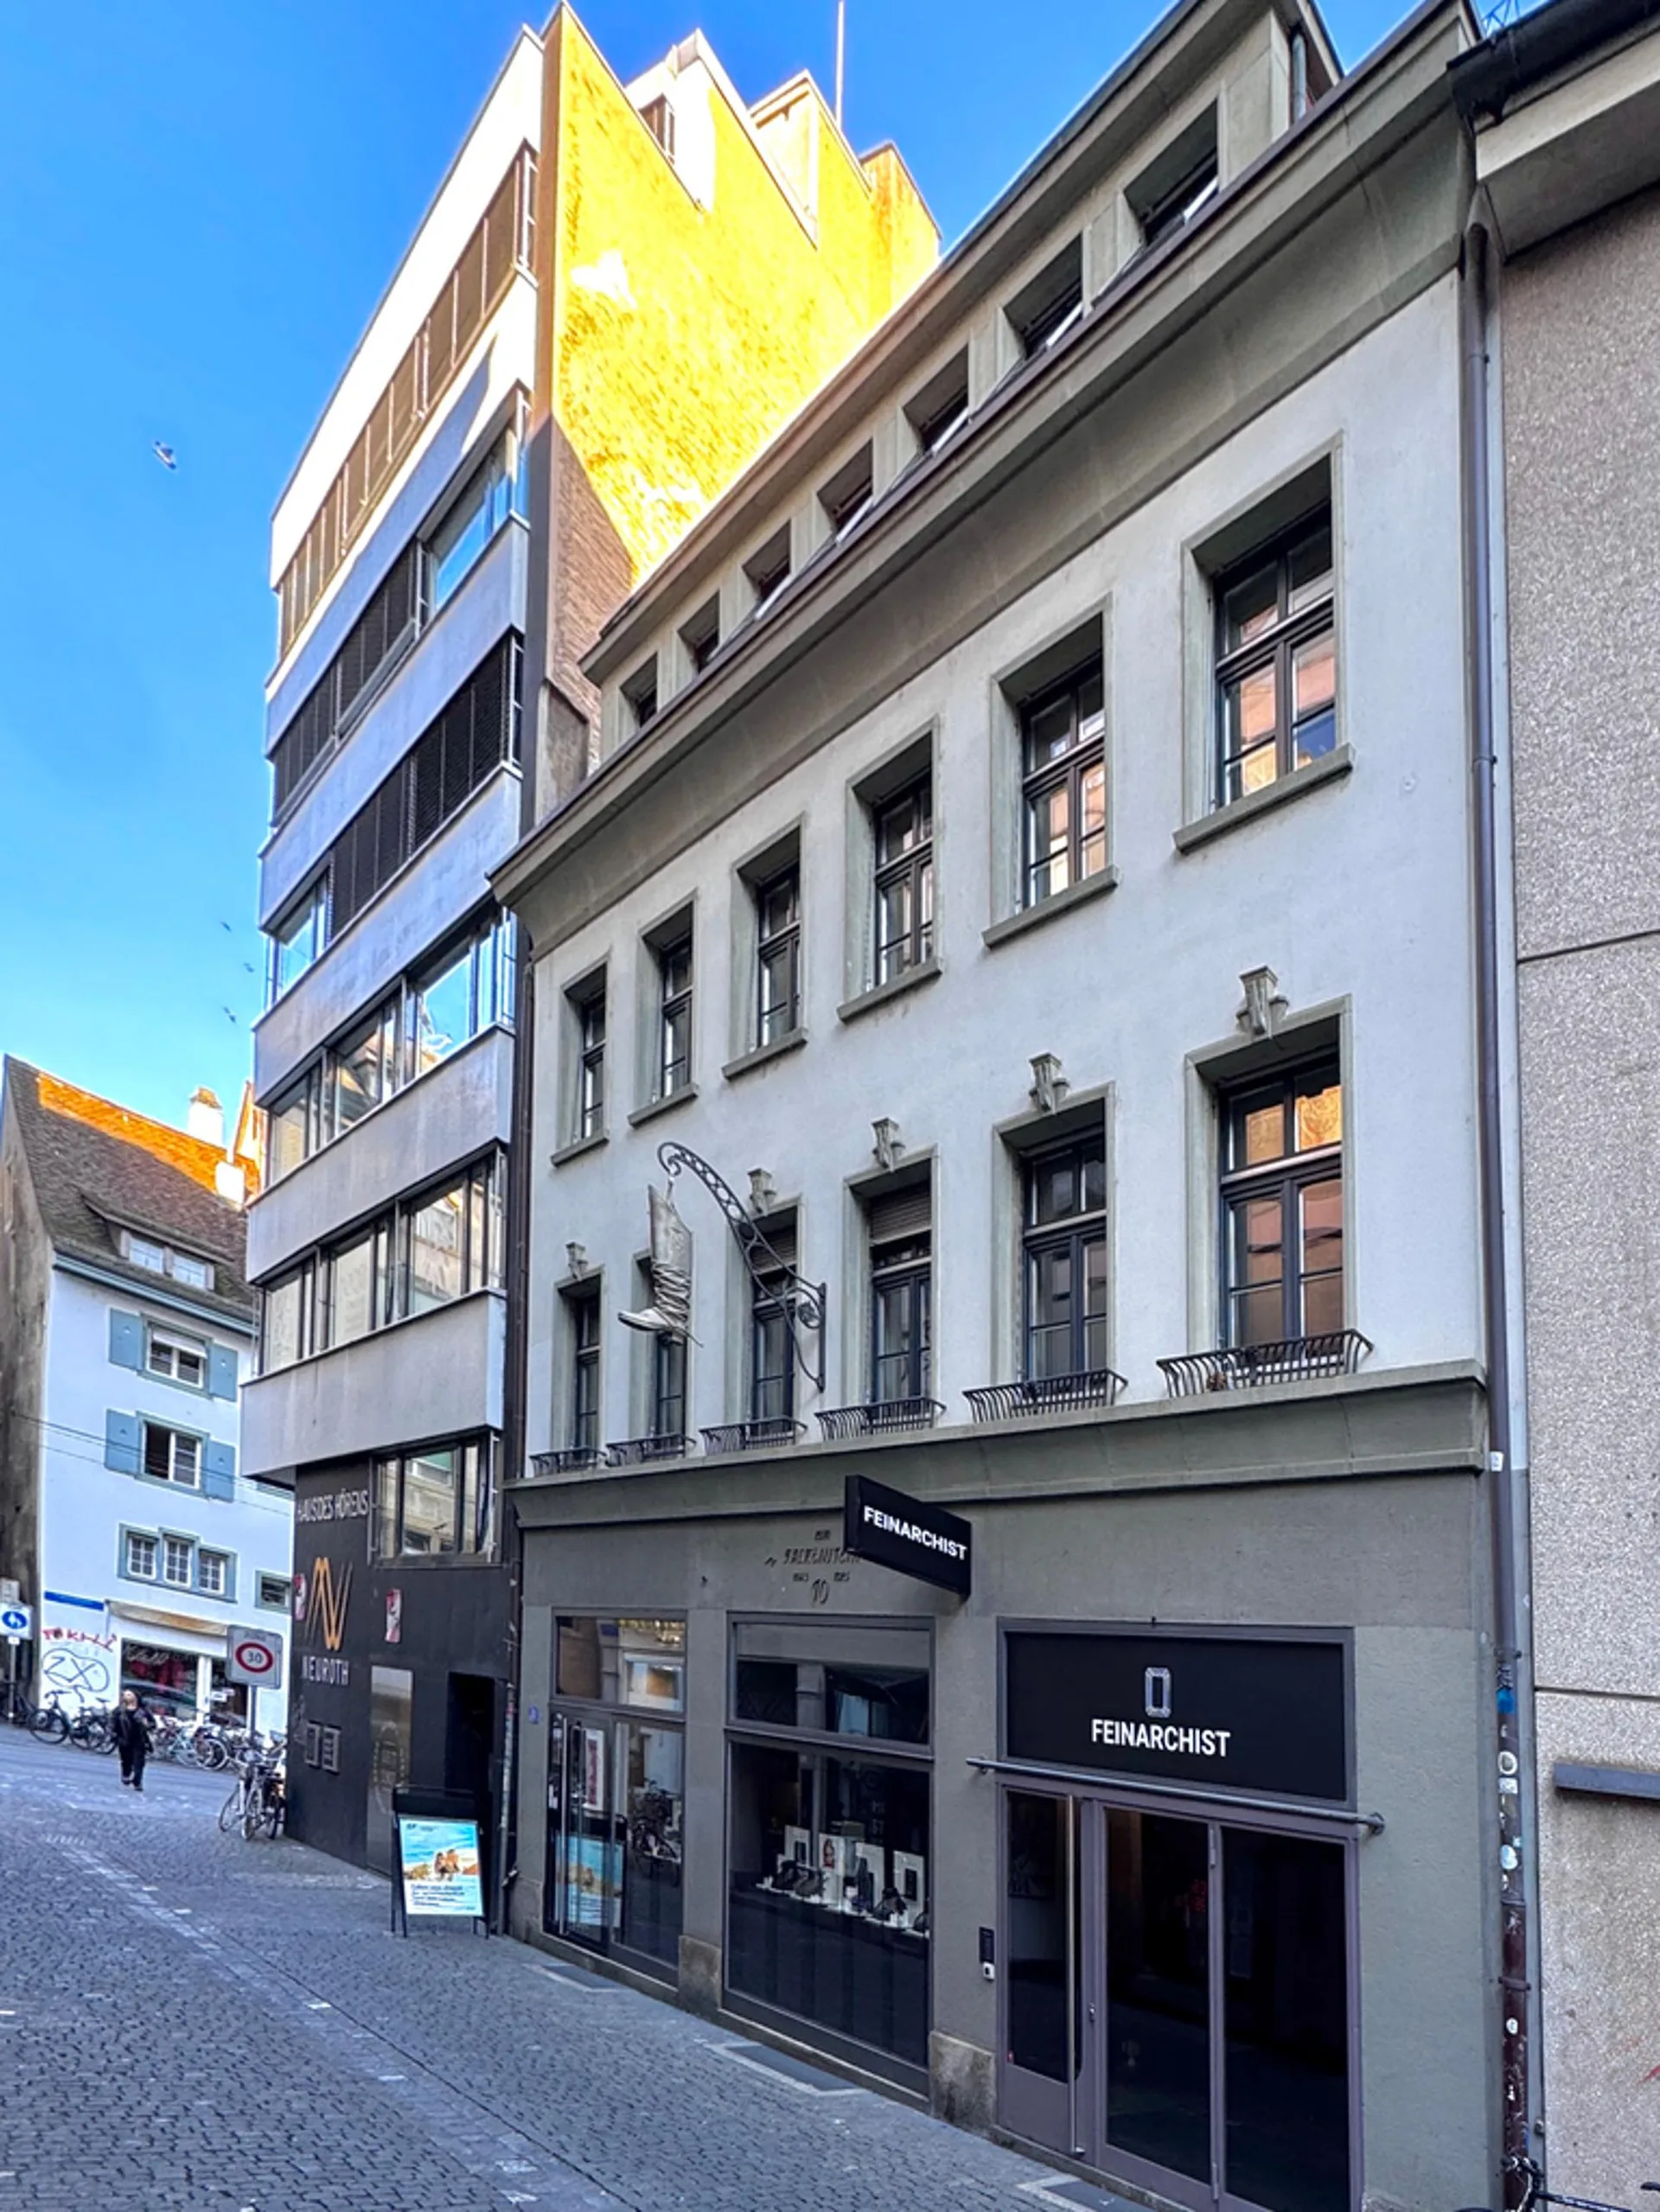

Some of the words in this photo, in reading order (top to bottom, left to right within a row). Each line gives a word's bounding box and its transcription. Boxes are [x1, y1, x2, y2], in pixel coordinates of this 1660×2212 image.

[864, 1505, 967, 1560] FEINARCHIST
[302, 1655, 349, 1686] NEUROTH
[1092, 1718, 1231, 1757] FEINARCHIST
